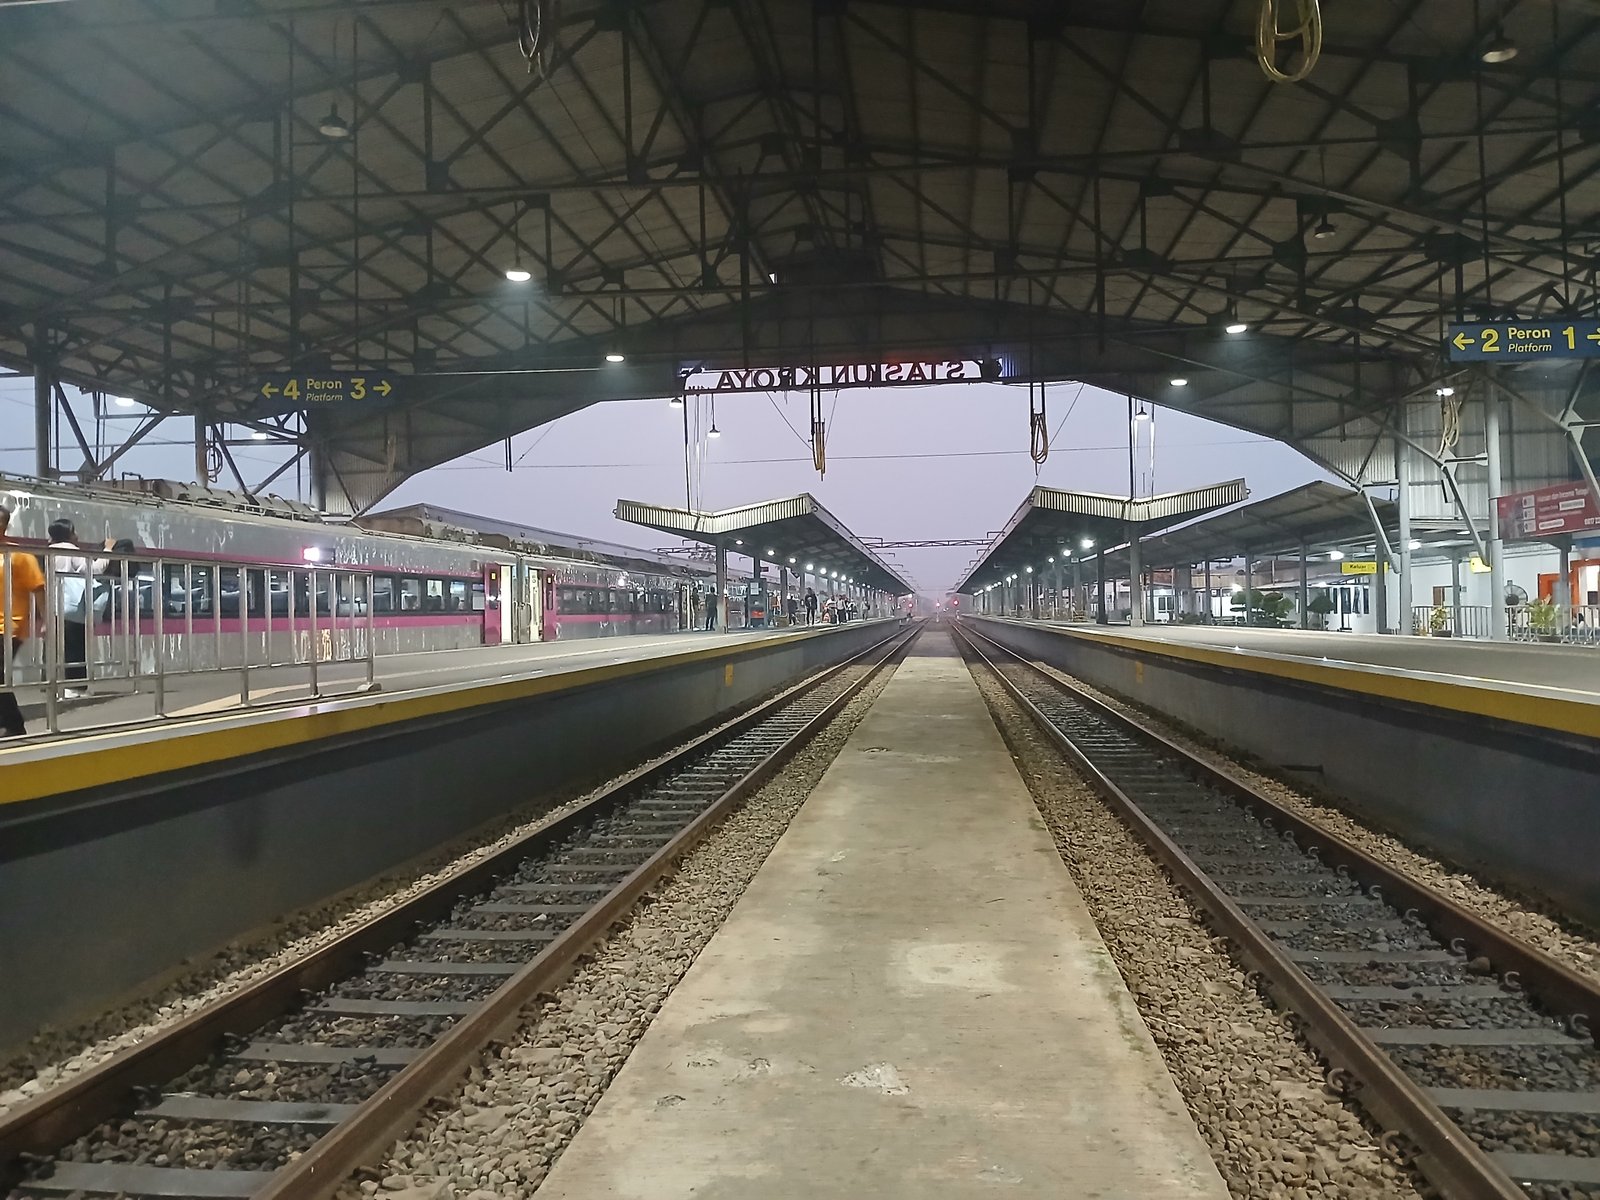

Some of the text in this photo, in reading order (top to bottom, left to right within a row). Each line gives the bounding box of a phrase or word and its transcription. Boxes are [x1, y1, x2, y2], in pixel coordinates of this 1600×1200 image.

[1481, 326, 1575, 352] 2 Peron 1
[1508, 343, 1552, 353] Platform
[283, 378, 366, 400] 4 Peron 3
[305, 392, 343, 401] Platform
